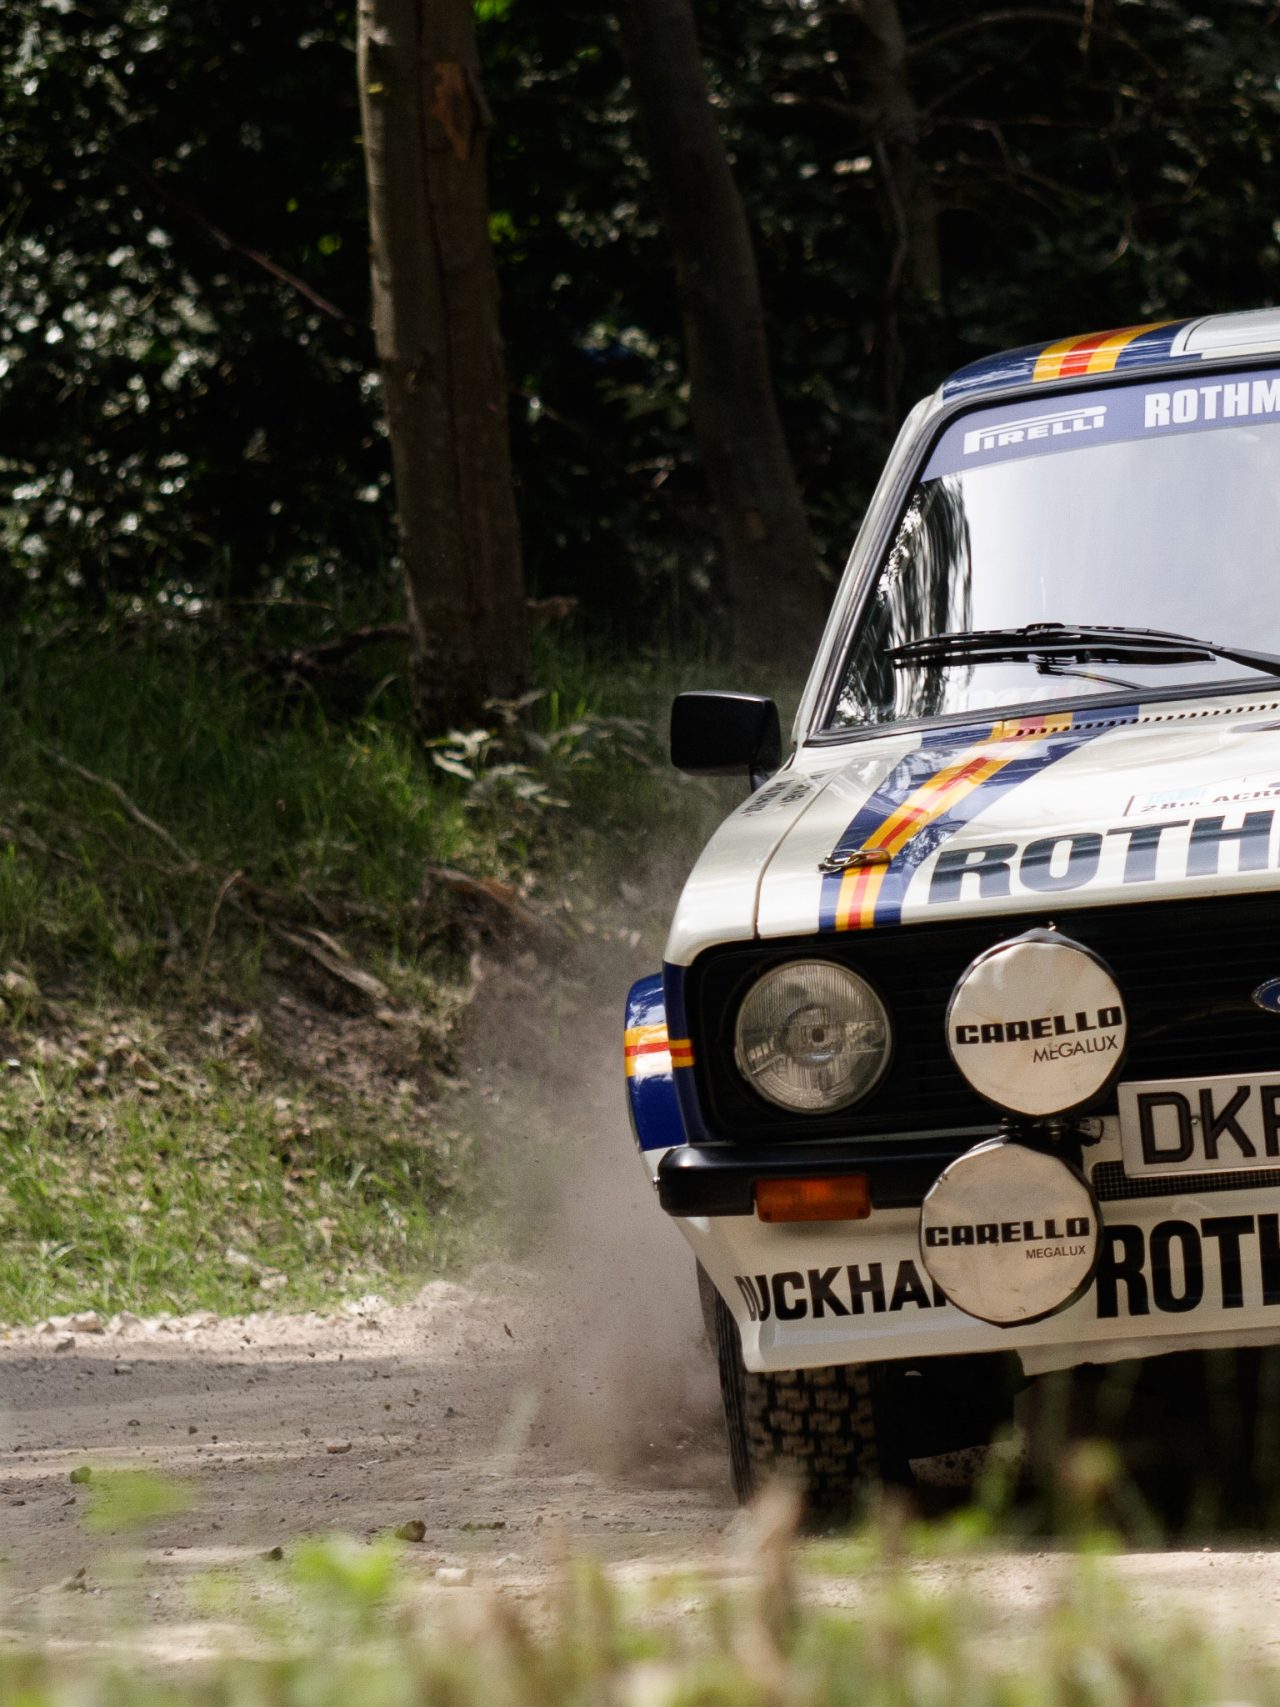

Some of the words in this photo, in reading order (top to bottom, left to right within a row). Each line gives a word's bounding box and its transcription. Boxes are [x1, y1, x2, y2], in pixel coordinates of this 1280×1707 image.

[963, 405, 1107, 455] PIRELLI
[955, 1006, 1123, 1045] CARELLO
[1033, 1035, 1118, 1063] MEGALUX
[925, 1217, 1090, 1247] CARELLO
[1025, 1245, 1087, 1259] MEGALUX
[734, 1259, 948, 1321] DUCKHA
